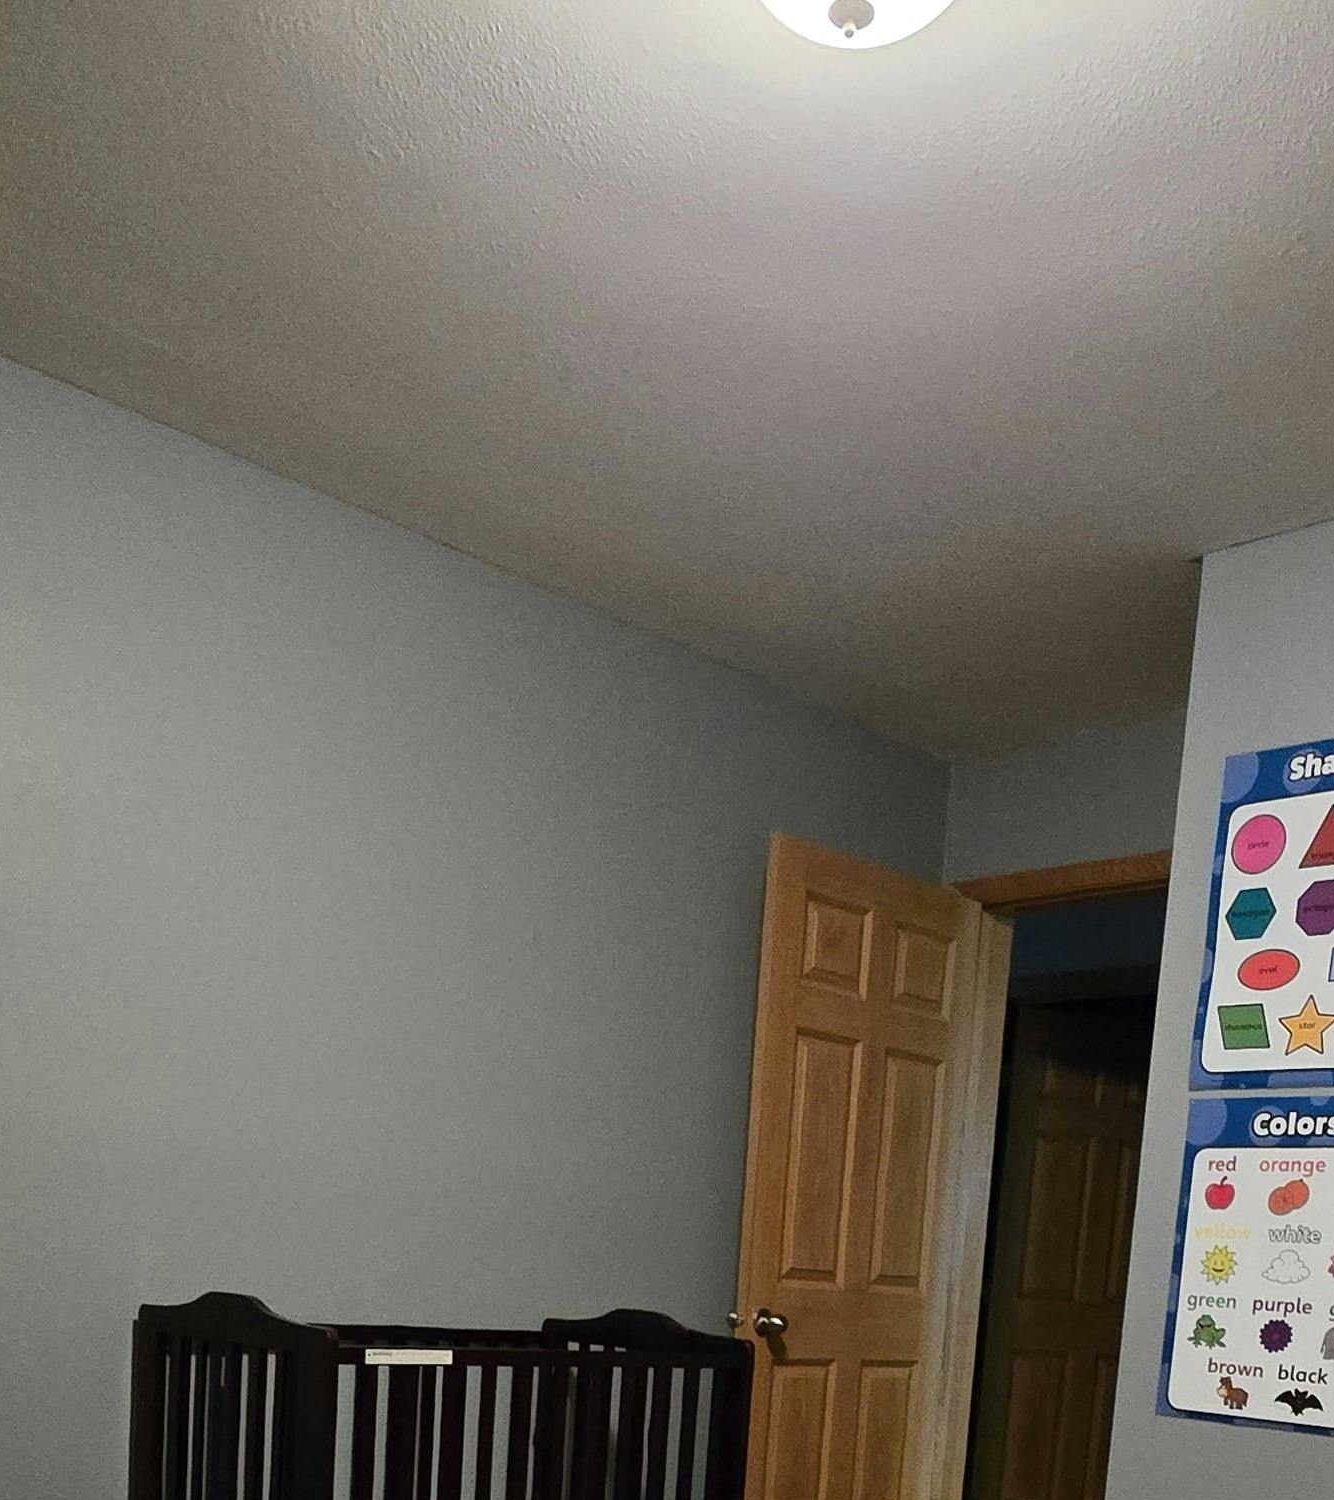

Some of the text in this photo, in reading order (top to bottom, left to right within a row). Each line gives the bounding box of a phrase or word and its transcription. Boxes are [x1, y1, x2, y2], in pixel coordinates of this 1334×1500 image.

[1208, 1156, 1237, 1173] red
[1259, 1157, 1327, 1177] orange
[1268, 1224, 1322, 1245] white
[1187, 1294, 1237, 1311] green
[1252, 1297, 1313, 1317] purple
[1208, 1357, 1264, 1378] brown
[1278, 1364, 1329, 1386] black
